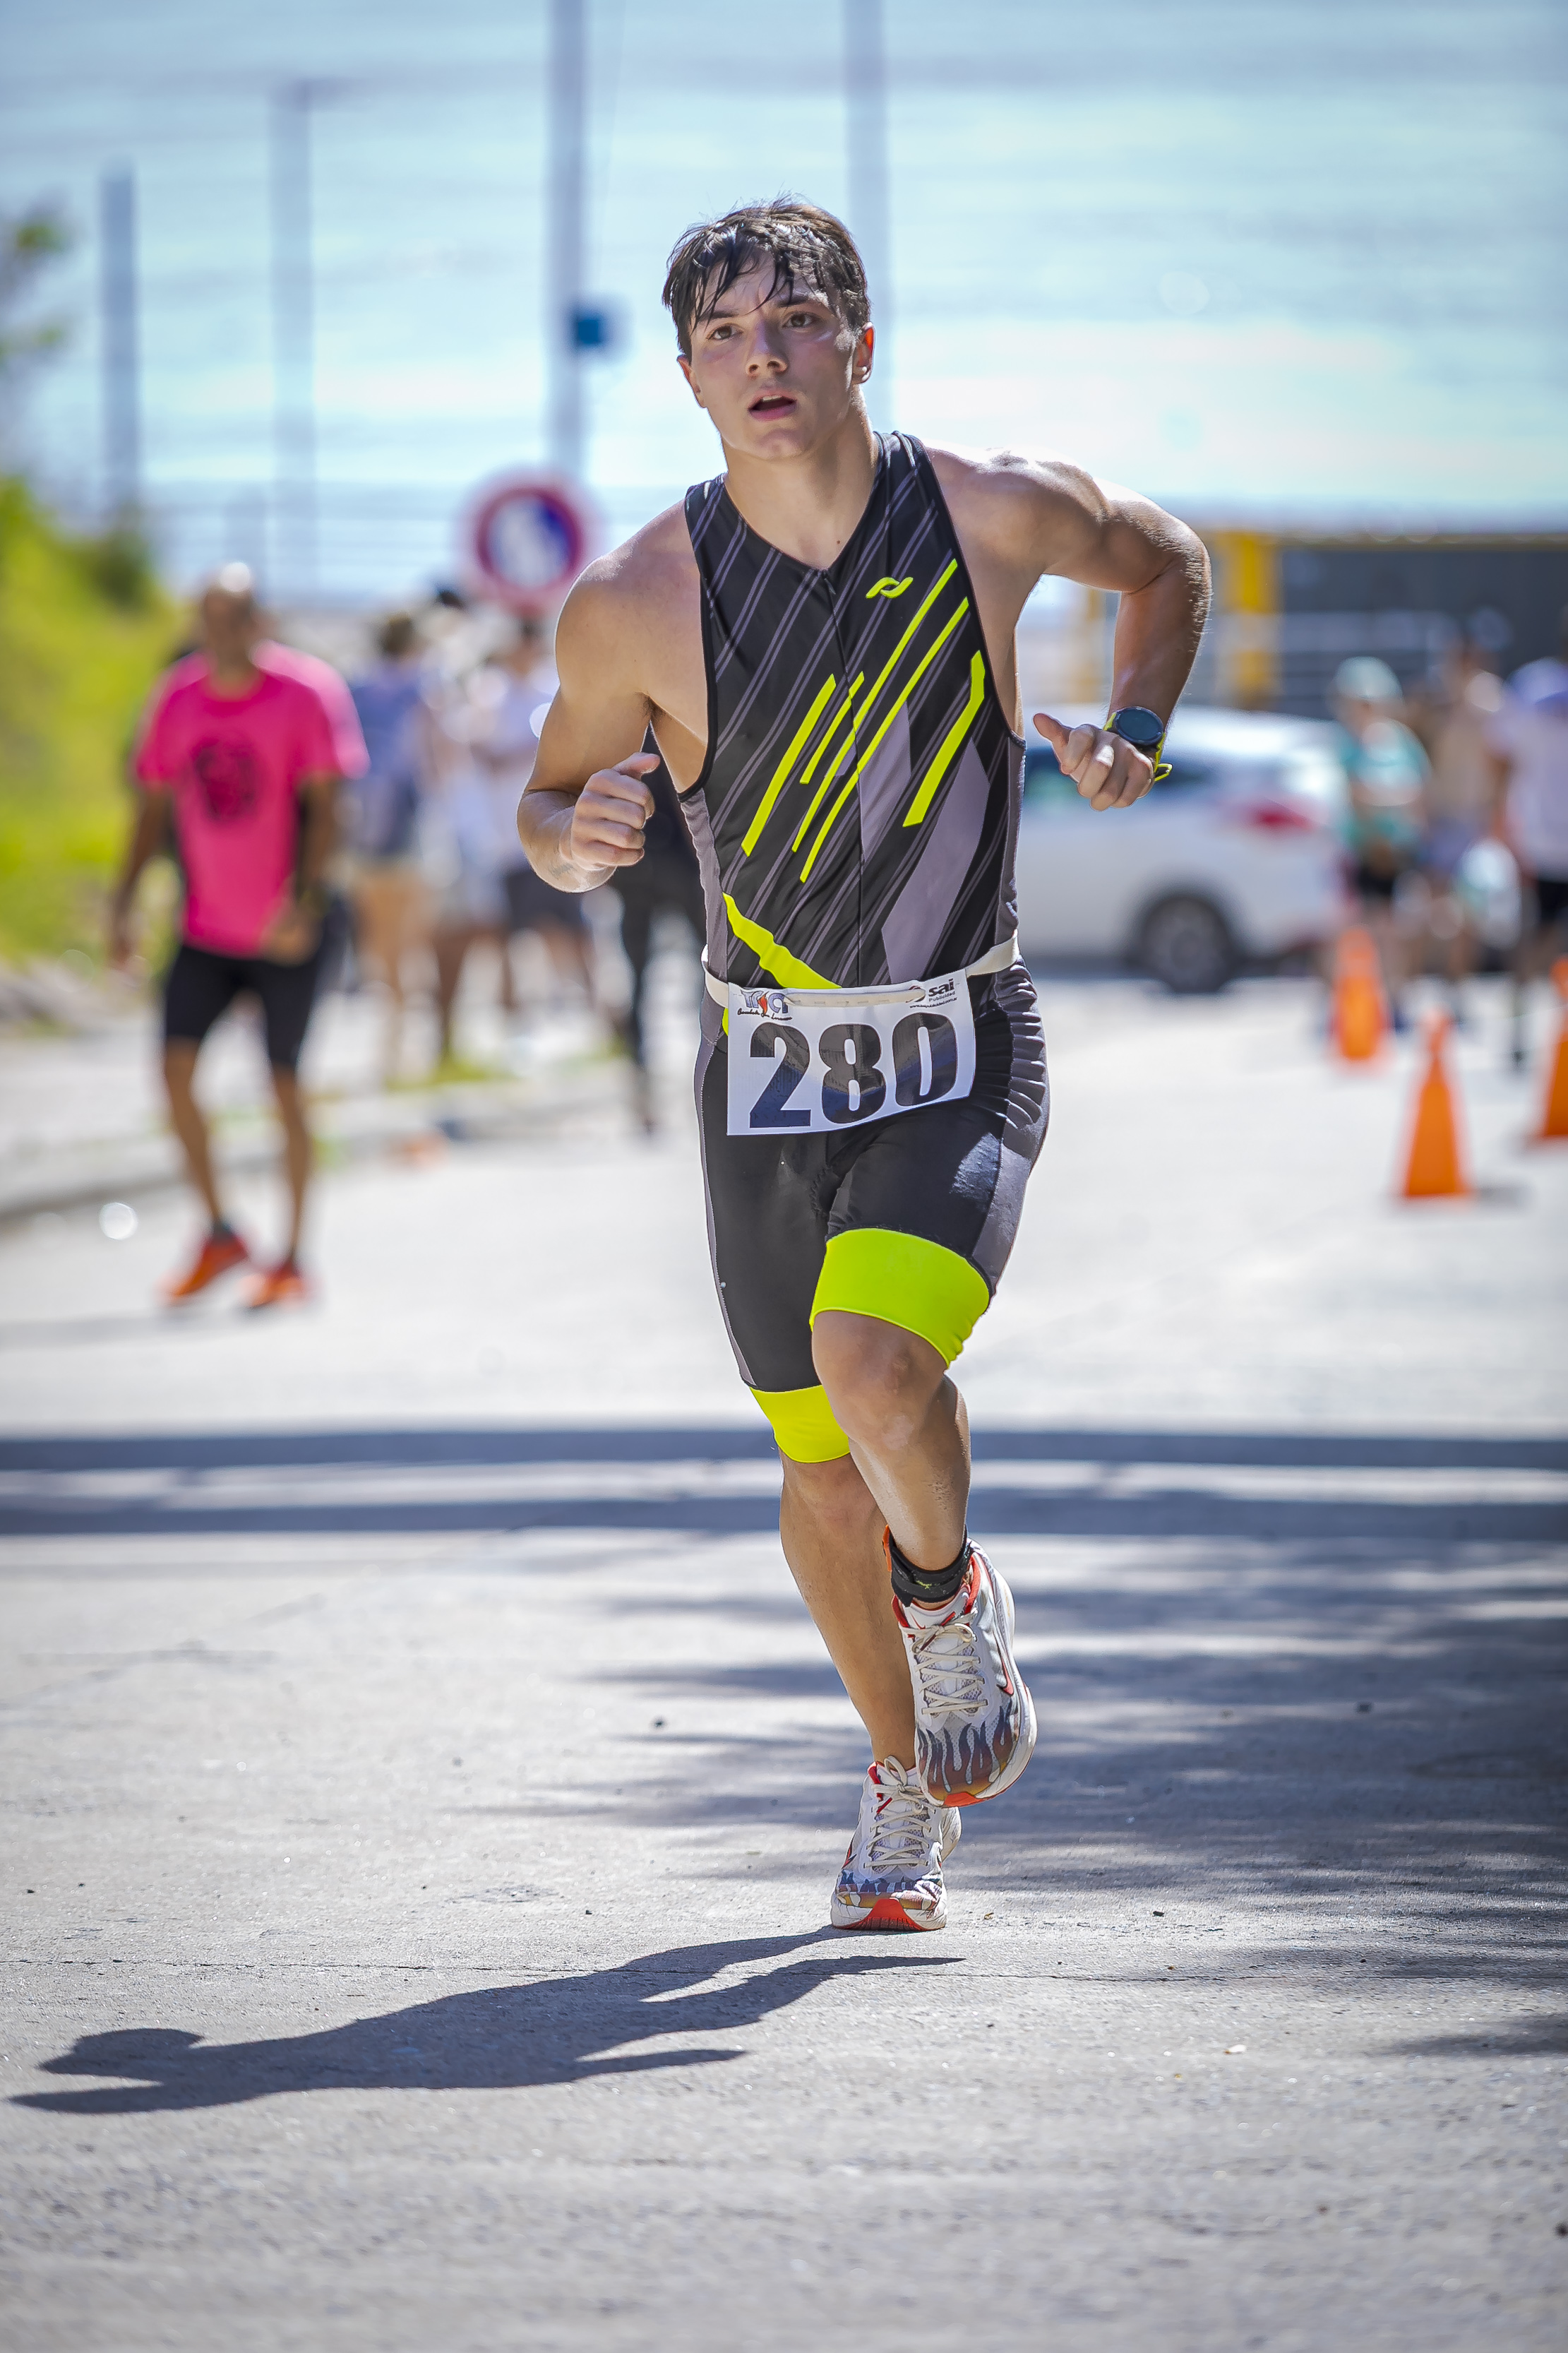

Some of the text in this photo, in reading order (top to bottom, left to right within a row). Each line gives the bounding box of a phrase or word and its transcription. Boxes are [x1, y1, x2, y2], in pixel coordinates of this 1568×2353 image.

[928, 978, 955, 996] sai
[928, 990, 956, 1002] Publicidad
[749, 1012, 958, 1128] 280
